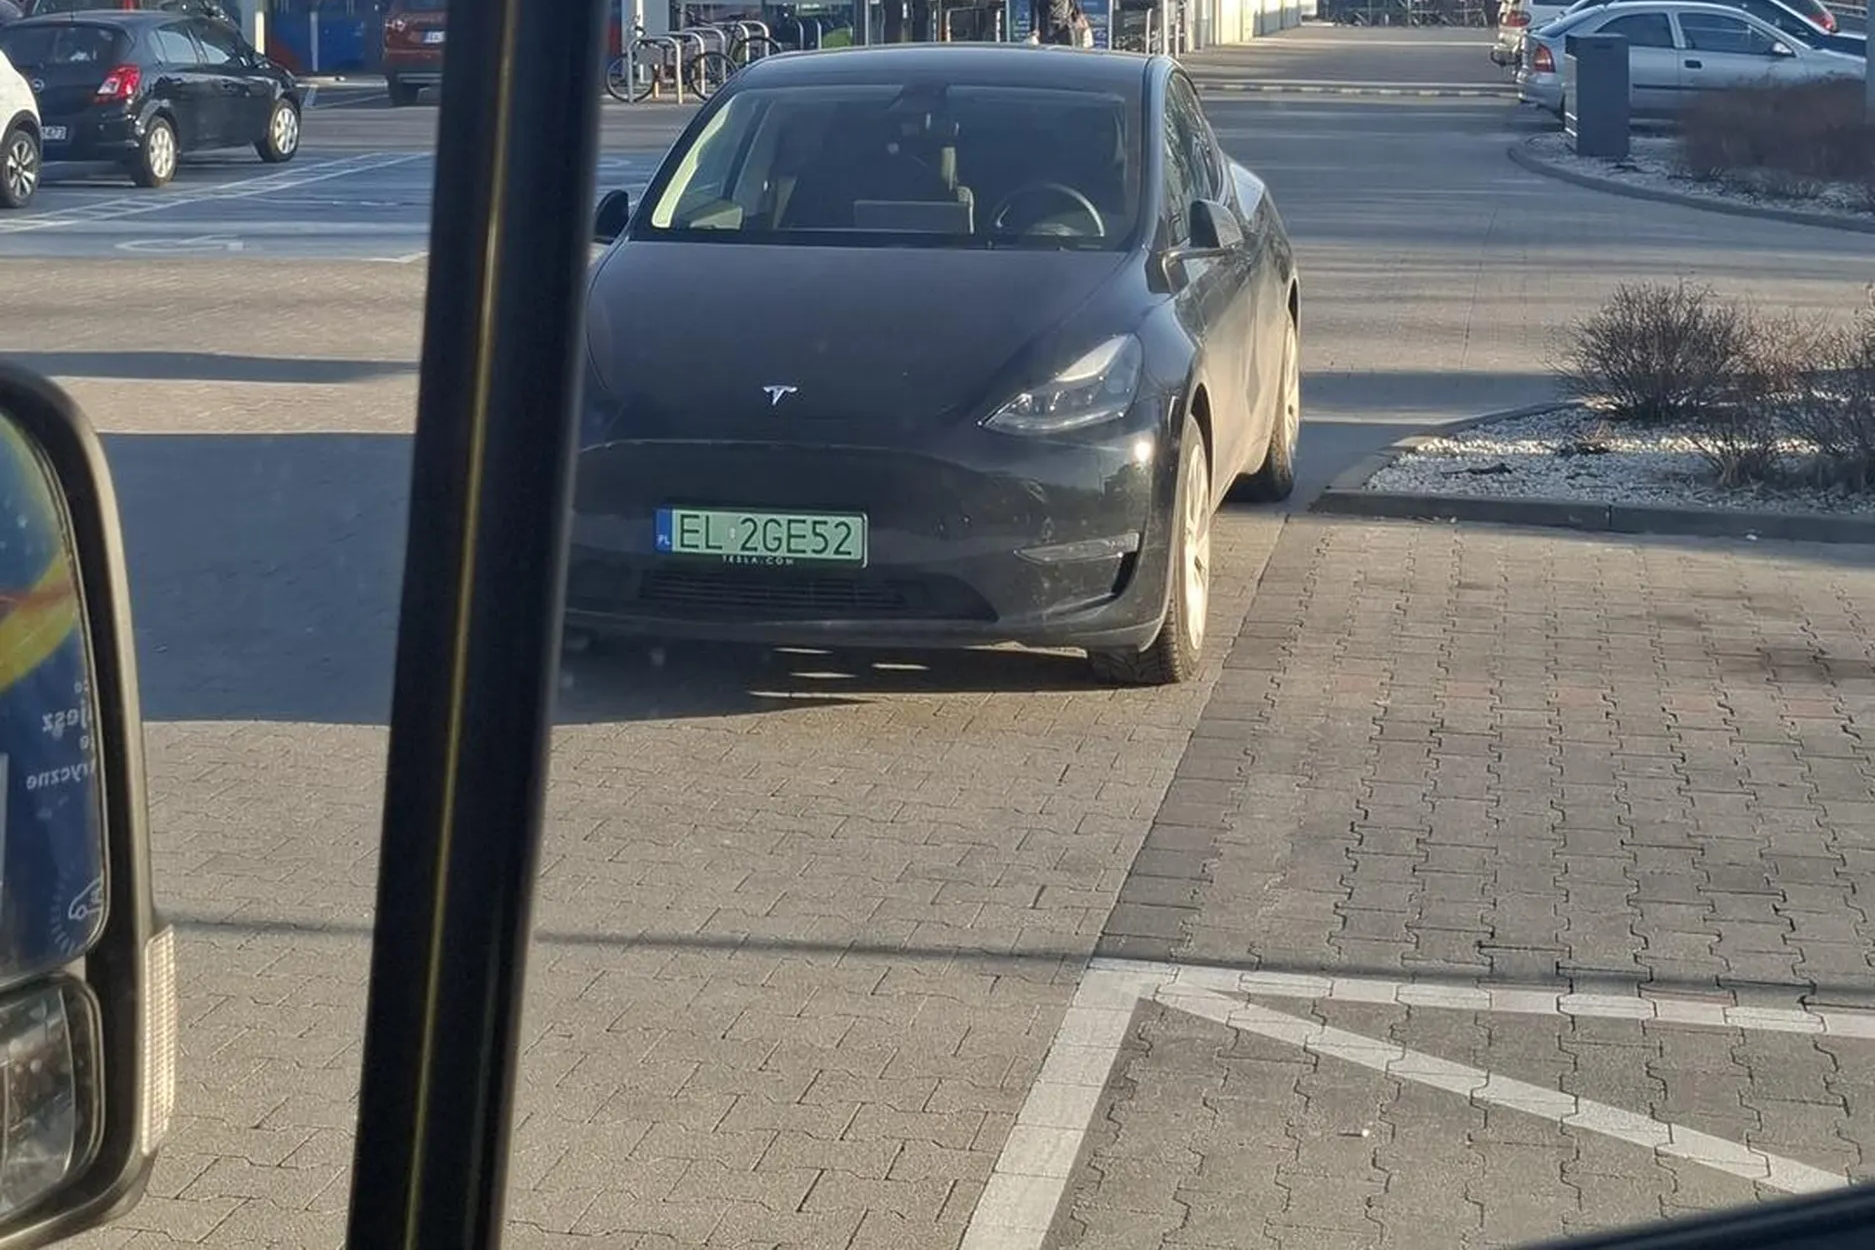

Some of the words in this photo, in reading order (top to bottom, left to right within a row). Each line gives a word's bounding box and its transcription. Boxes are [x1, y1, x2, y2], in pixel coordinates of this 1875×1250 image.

[656, 533, 671, 546] PL
[679, 514, 723, 550] EL
[740, 518, 852, 556] 2GE52
